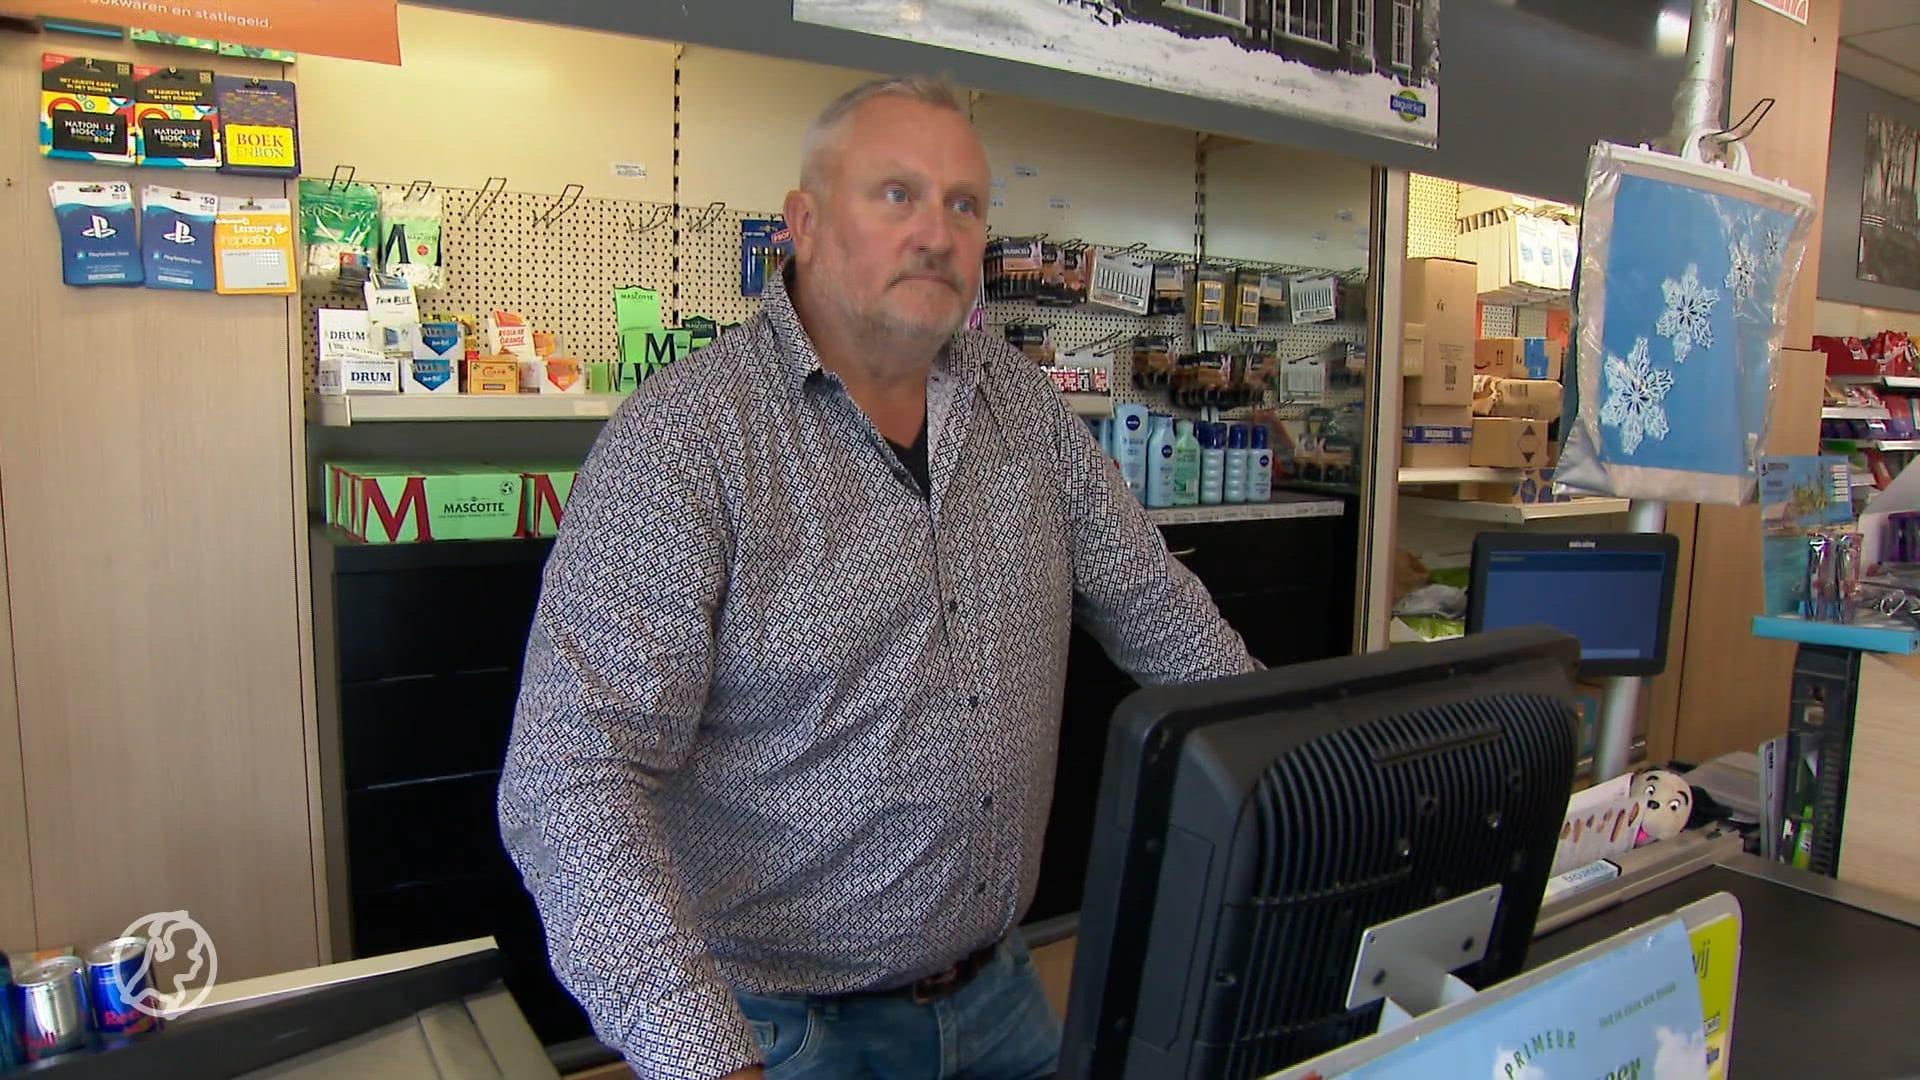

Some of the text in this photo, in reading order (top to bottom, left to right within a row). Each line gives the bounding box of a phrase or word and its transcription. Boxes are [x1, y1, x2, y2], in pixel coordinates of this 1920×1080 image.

[172, 8, 192, 17] en
[237, 133, 284, 148] BOEK
[330, 331, 366, 340] DRUM
[351, 371, 392, 382] DRUM
[361, 476, 435, 544] M
[443, 501, 505, 513] MASCOTTE
[1504, 1028, 1577, 1080] PRIMEUR
